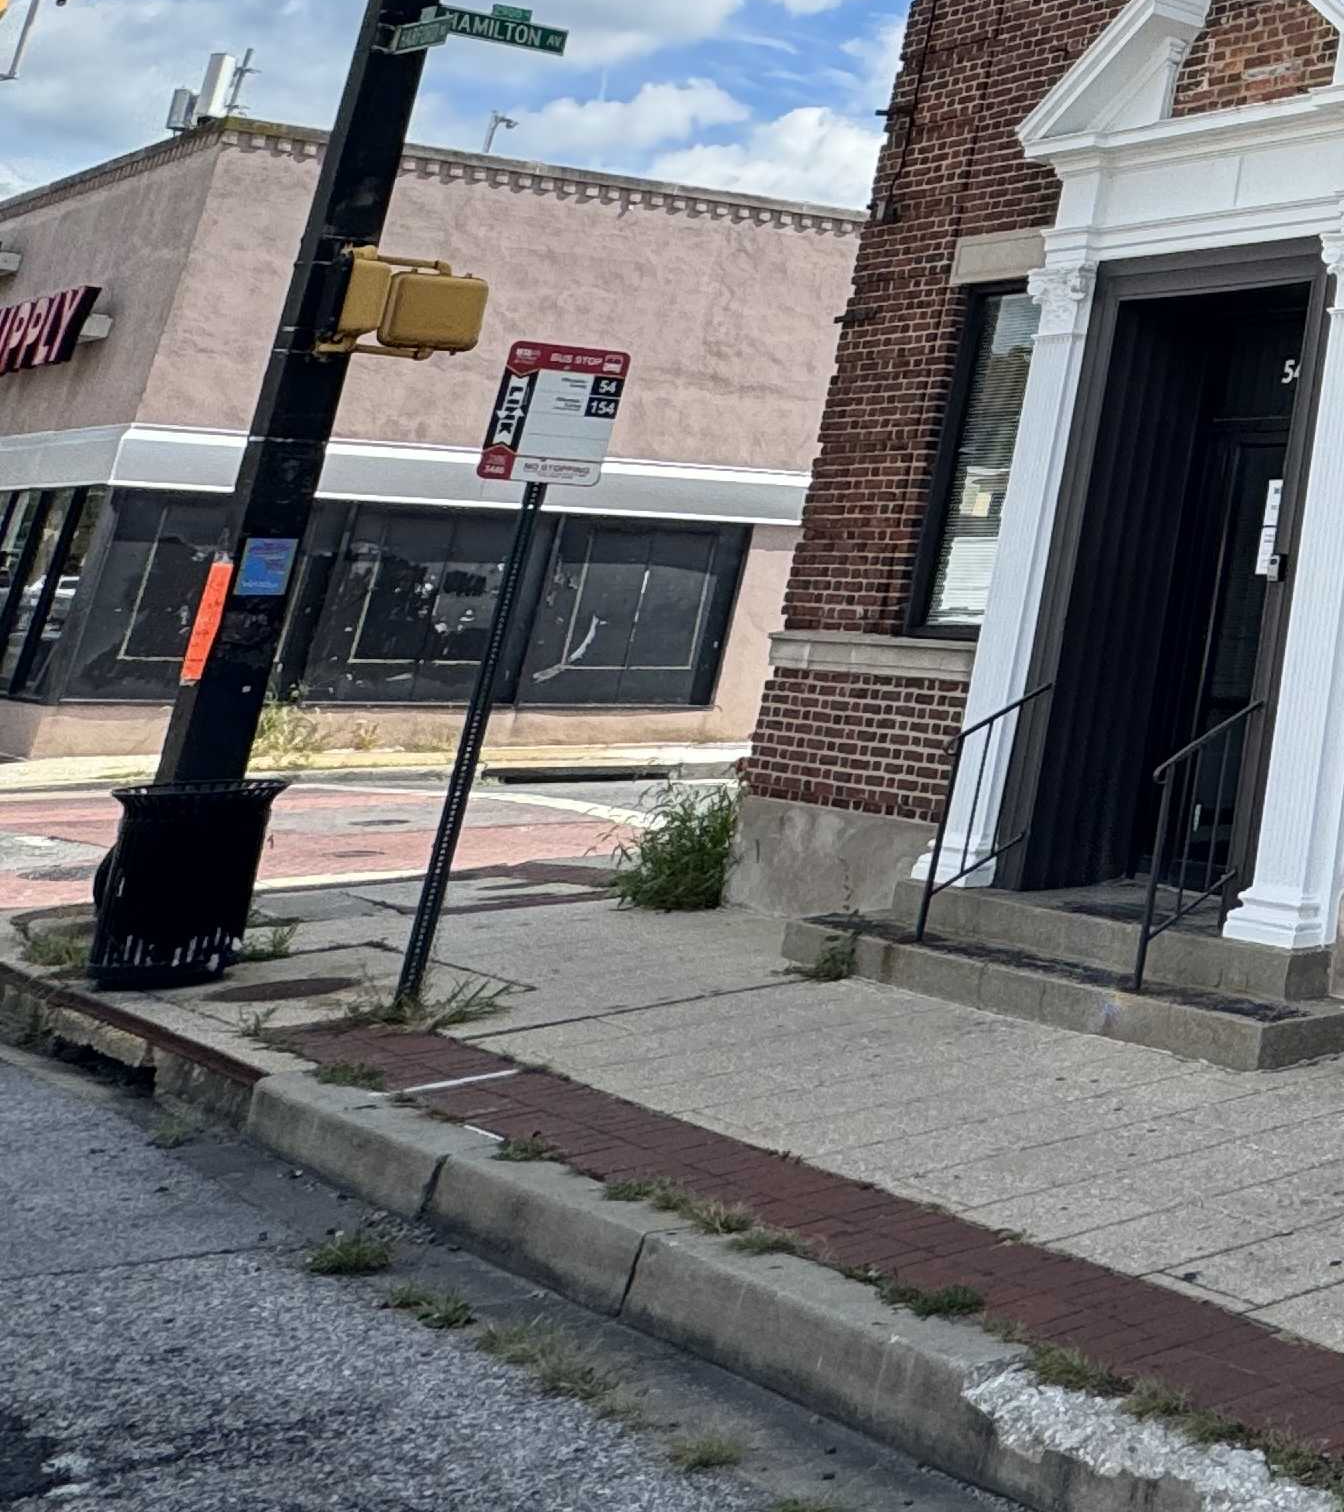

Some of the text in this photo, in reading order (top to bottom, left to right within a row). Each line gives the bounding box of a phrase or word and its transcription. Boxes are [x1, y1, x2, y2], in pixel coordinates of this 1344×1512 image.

[446, 9, 542, 46] HAMILTON
[550, 352, 574, 364] BUS
[574, 354, 604, 366] STOP
[599, 380, 617, 394] 54
[591, 400, 615, 415] 154
